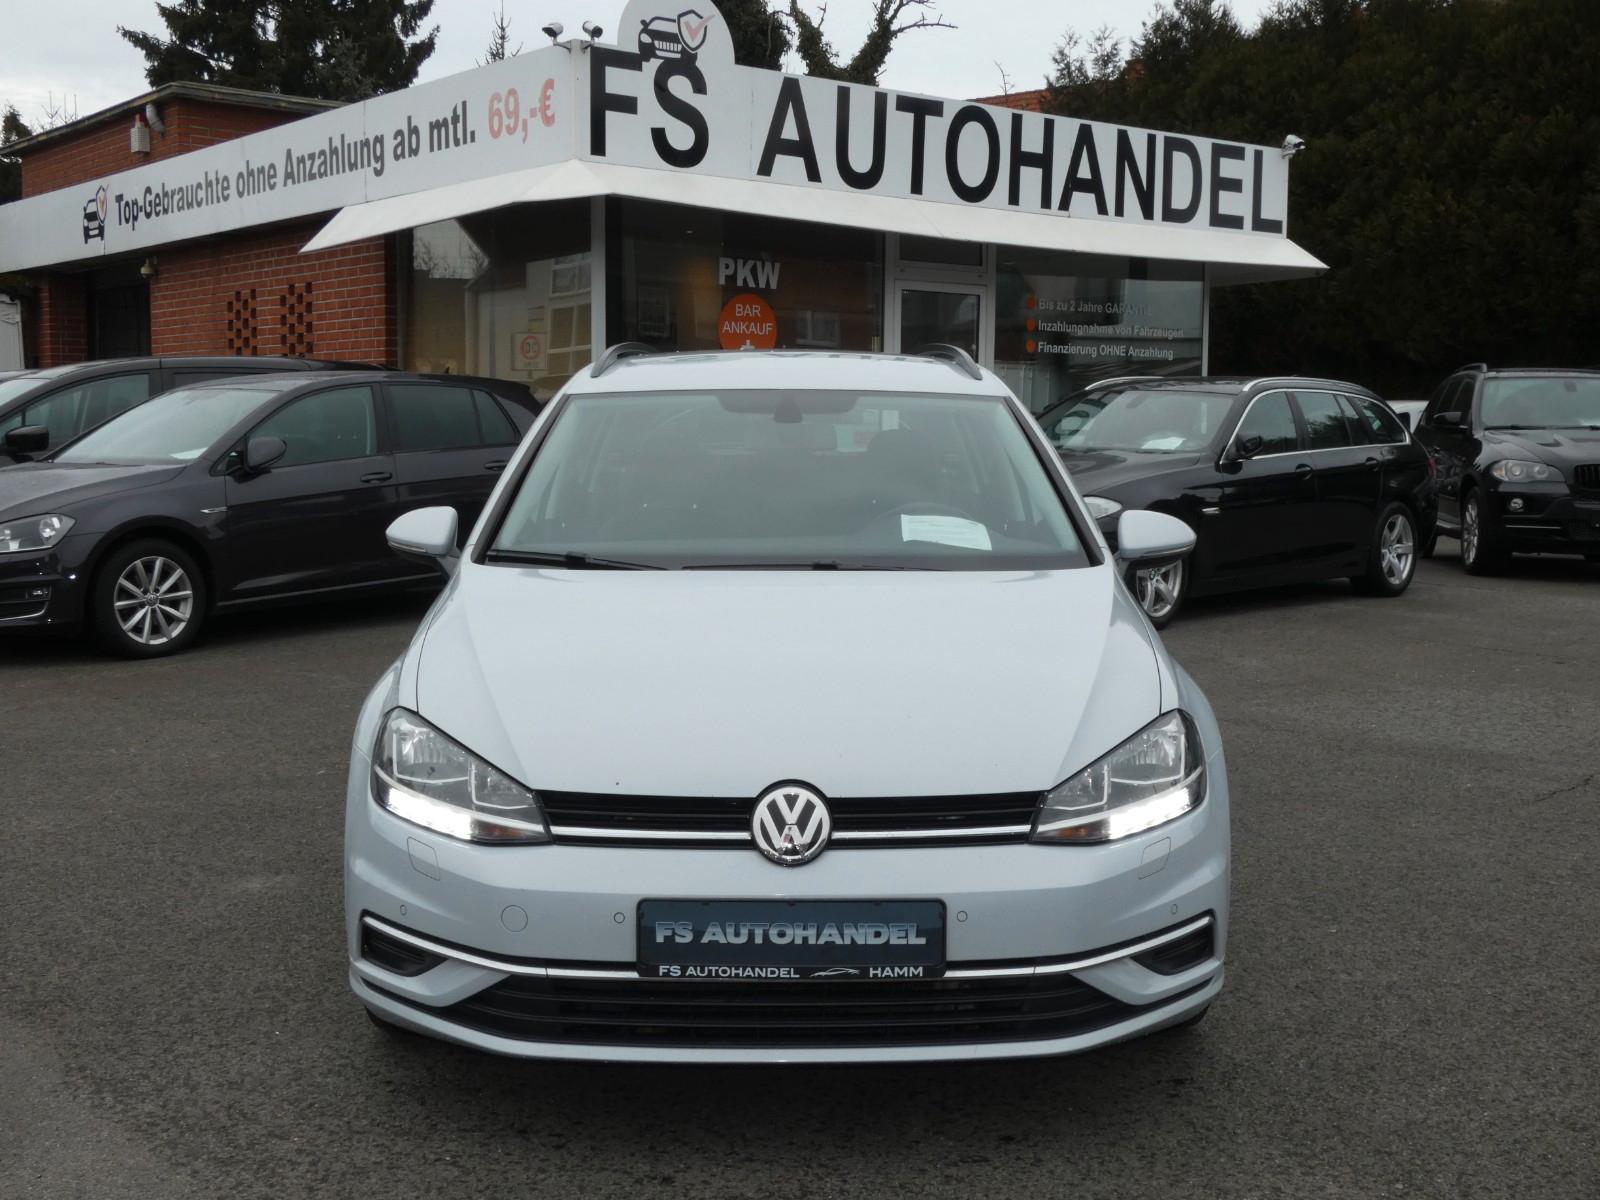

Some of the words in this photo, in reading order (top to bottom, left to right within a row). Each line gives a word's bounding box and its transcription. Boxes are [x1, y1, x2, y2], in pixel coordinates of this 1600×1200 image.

[589, 47, 709, 168] FS
[757, 76, 1284, 234] AUTOHANDEL
[115, 170, 231, 231] Top-Gebrauchte
[236, 160, 277, 198] ohne
[283, 133, 385, 187] Anzahlung
[393, 114, 421, 162] ab
[428, 100, 476, 153] mtl.
[487, 78, 556, 145] 69,-€
[718, 257, 781, 289] PKW
[735, 304, 761, 318] BAR
[1039, 300, 1055, 310] Bis
[1056, 301, 1068, 310] zu
[1070, 302, 1076, 312] 2
[1077, 302, 1104, 313] Jahre
[722, 321, 773, 335] ANKAUF
[1038, 320, 1113, 336] Inzahlungnahme
[1115, 327, 1133, 335] von
[1038, 342, 1098, 357] Finanzierung
[1099, 345, 1127, 356] OHNE
[1128, 345, 1174, 361] Anzahlung
[655, 921, 693, 943] FS
[701, 923, 927, 945] AUTOHANDEL
[659, 965, 681, 976] FS
[685, 967, 800, 978] AUTOHANDEL
[869, 967, 924, 977] HAMM
